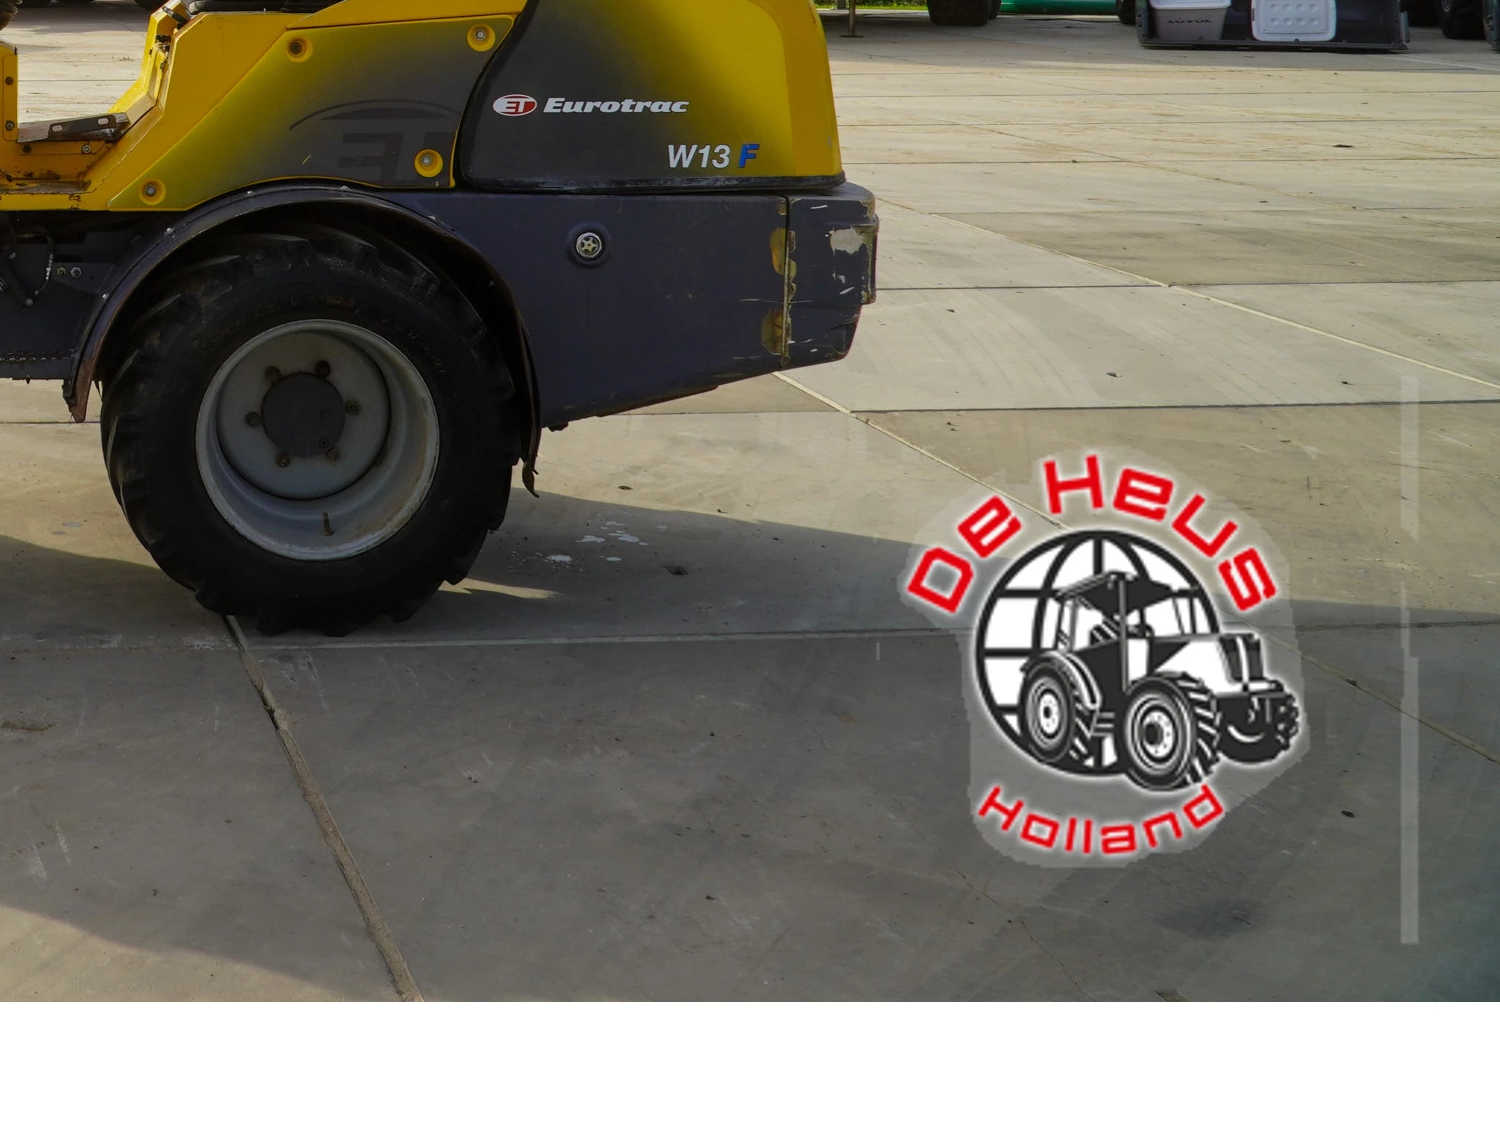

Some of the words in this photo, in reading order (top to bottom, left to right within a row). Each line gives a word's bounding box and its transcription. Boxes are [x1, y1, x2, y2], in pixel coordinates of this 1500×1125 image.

[543, 97, 690, 113] Eurotrac
[667, 144, 730, 168] W13
[738, 143, 760, 168] F
